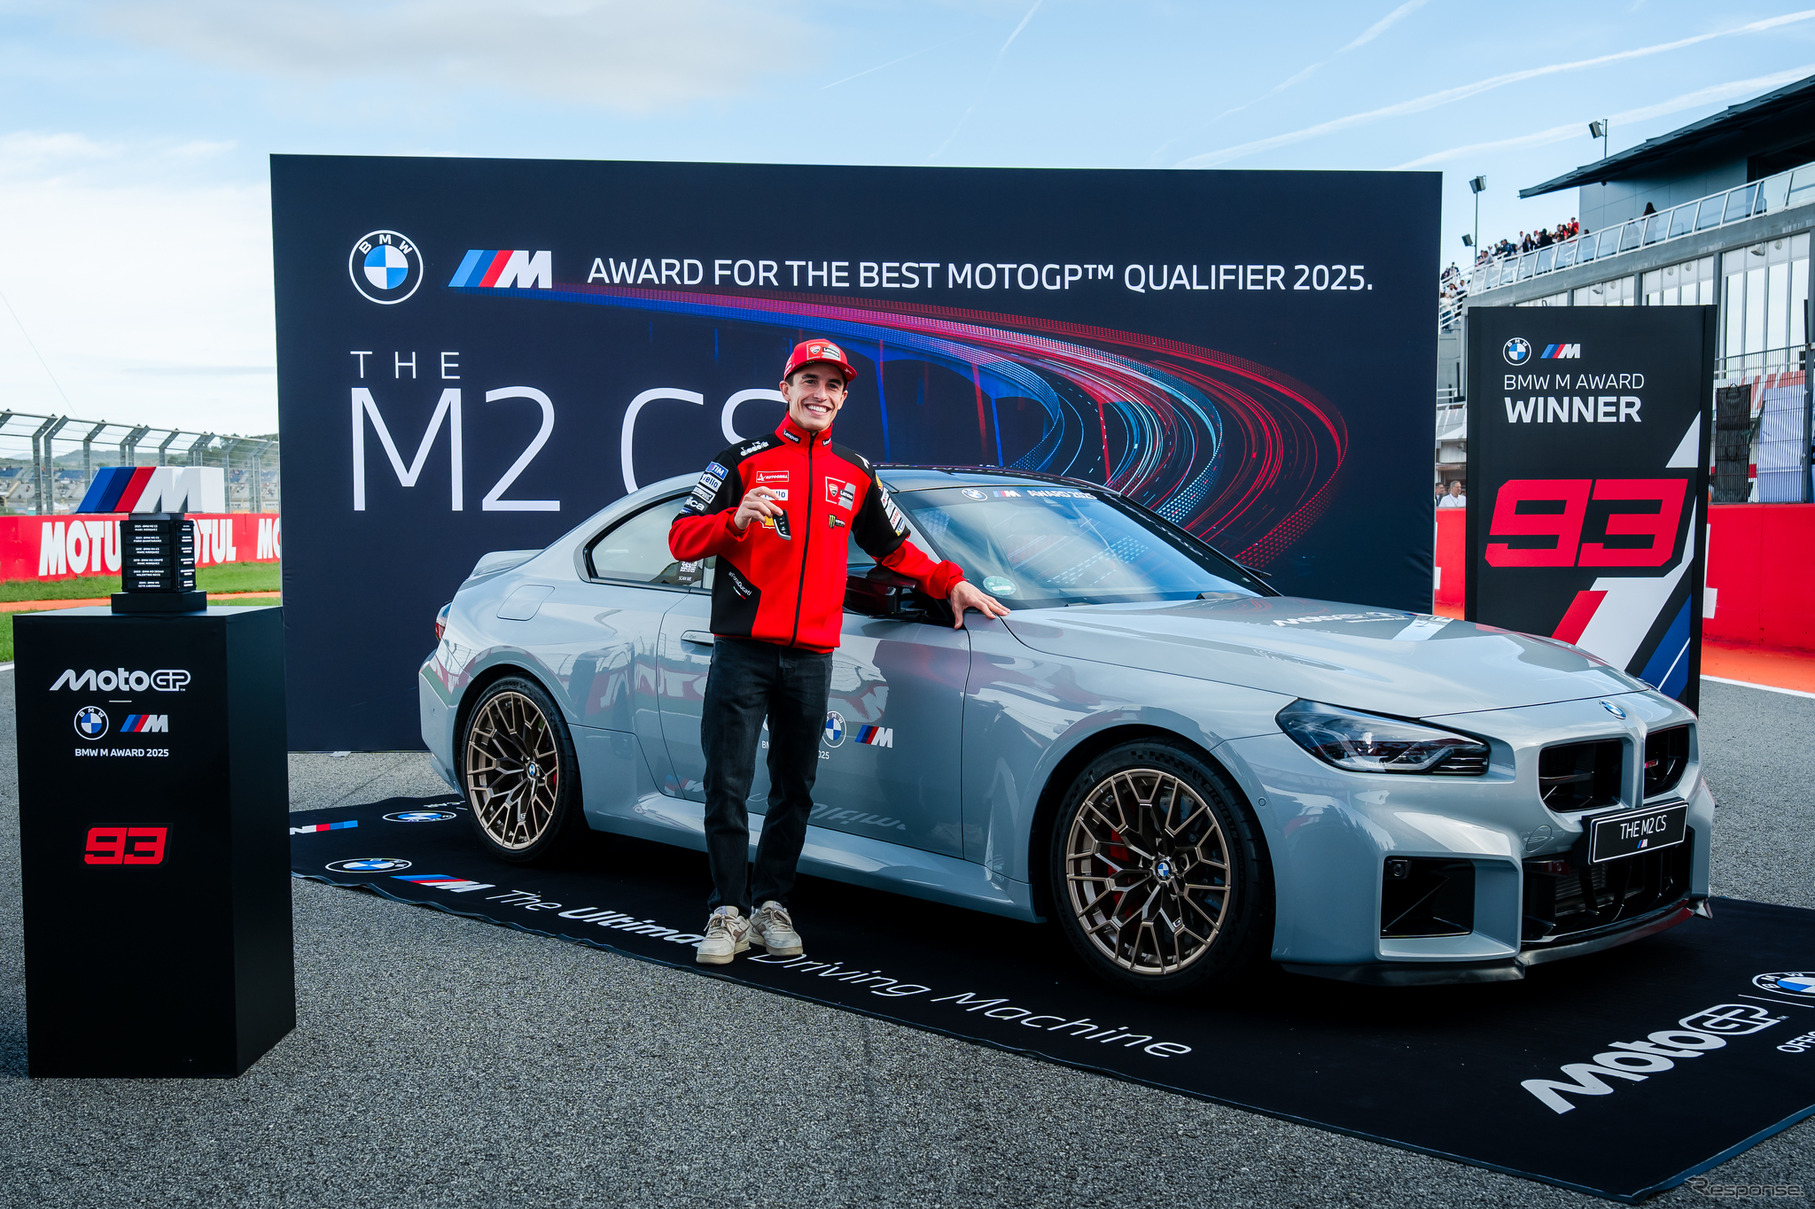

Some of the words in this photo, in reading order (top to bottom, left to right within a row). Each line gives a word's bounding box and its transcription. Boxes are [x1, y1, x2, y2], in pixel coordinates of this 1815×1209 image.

[359, 234, 413, 255] BMW
[588, 258, 704, 285] AWARD
[715, 260, 779, 286] FOR
[785, 261, 850, 287] THE
[860, 262, 940, 289] BEST
[1125, 265, 1286, 293] QUALIFIER
[1294, 265, 1373, 291] 2025.
[350, 351, 460, 379] THE
[1504, 374, 1550, 390] BMW
[1555, 374, 1570, 390] M
[1576, 373, 1645, 390] AWARD
[1504, 396, 1642, 423] WINNER
[352, 386, 560, 511] M2
[712, 464, 726, 476] TIM
[1485, 479, 1688, 567] 93
[38, 519, 121, 577] MOTU
[75, 749, 99, 757] BMW
[100, 749, 109, 757] M
[110, 749, 145, 757] AWARD
[146, 749, 169, 757] 2025
[1620, 820, 1641, 840] THE
[1641, 817, 1655, 836] M2
[1655, 814, 1668, 832] CS
[84, 827, 168, 865] 93
[486, 889, 562, 912] The
[557, 907, 705, 948] Ultima
[747, 953, 932, 997] Driving
[931, 992, 1193, 1059] Machine
